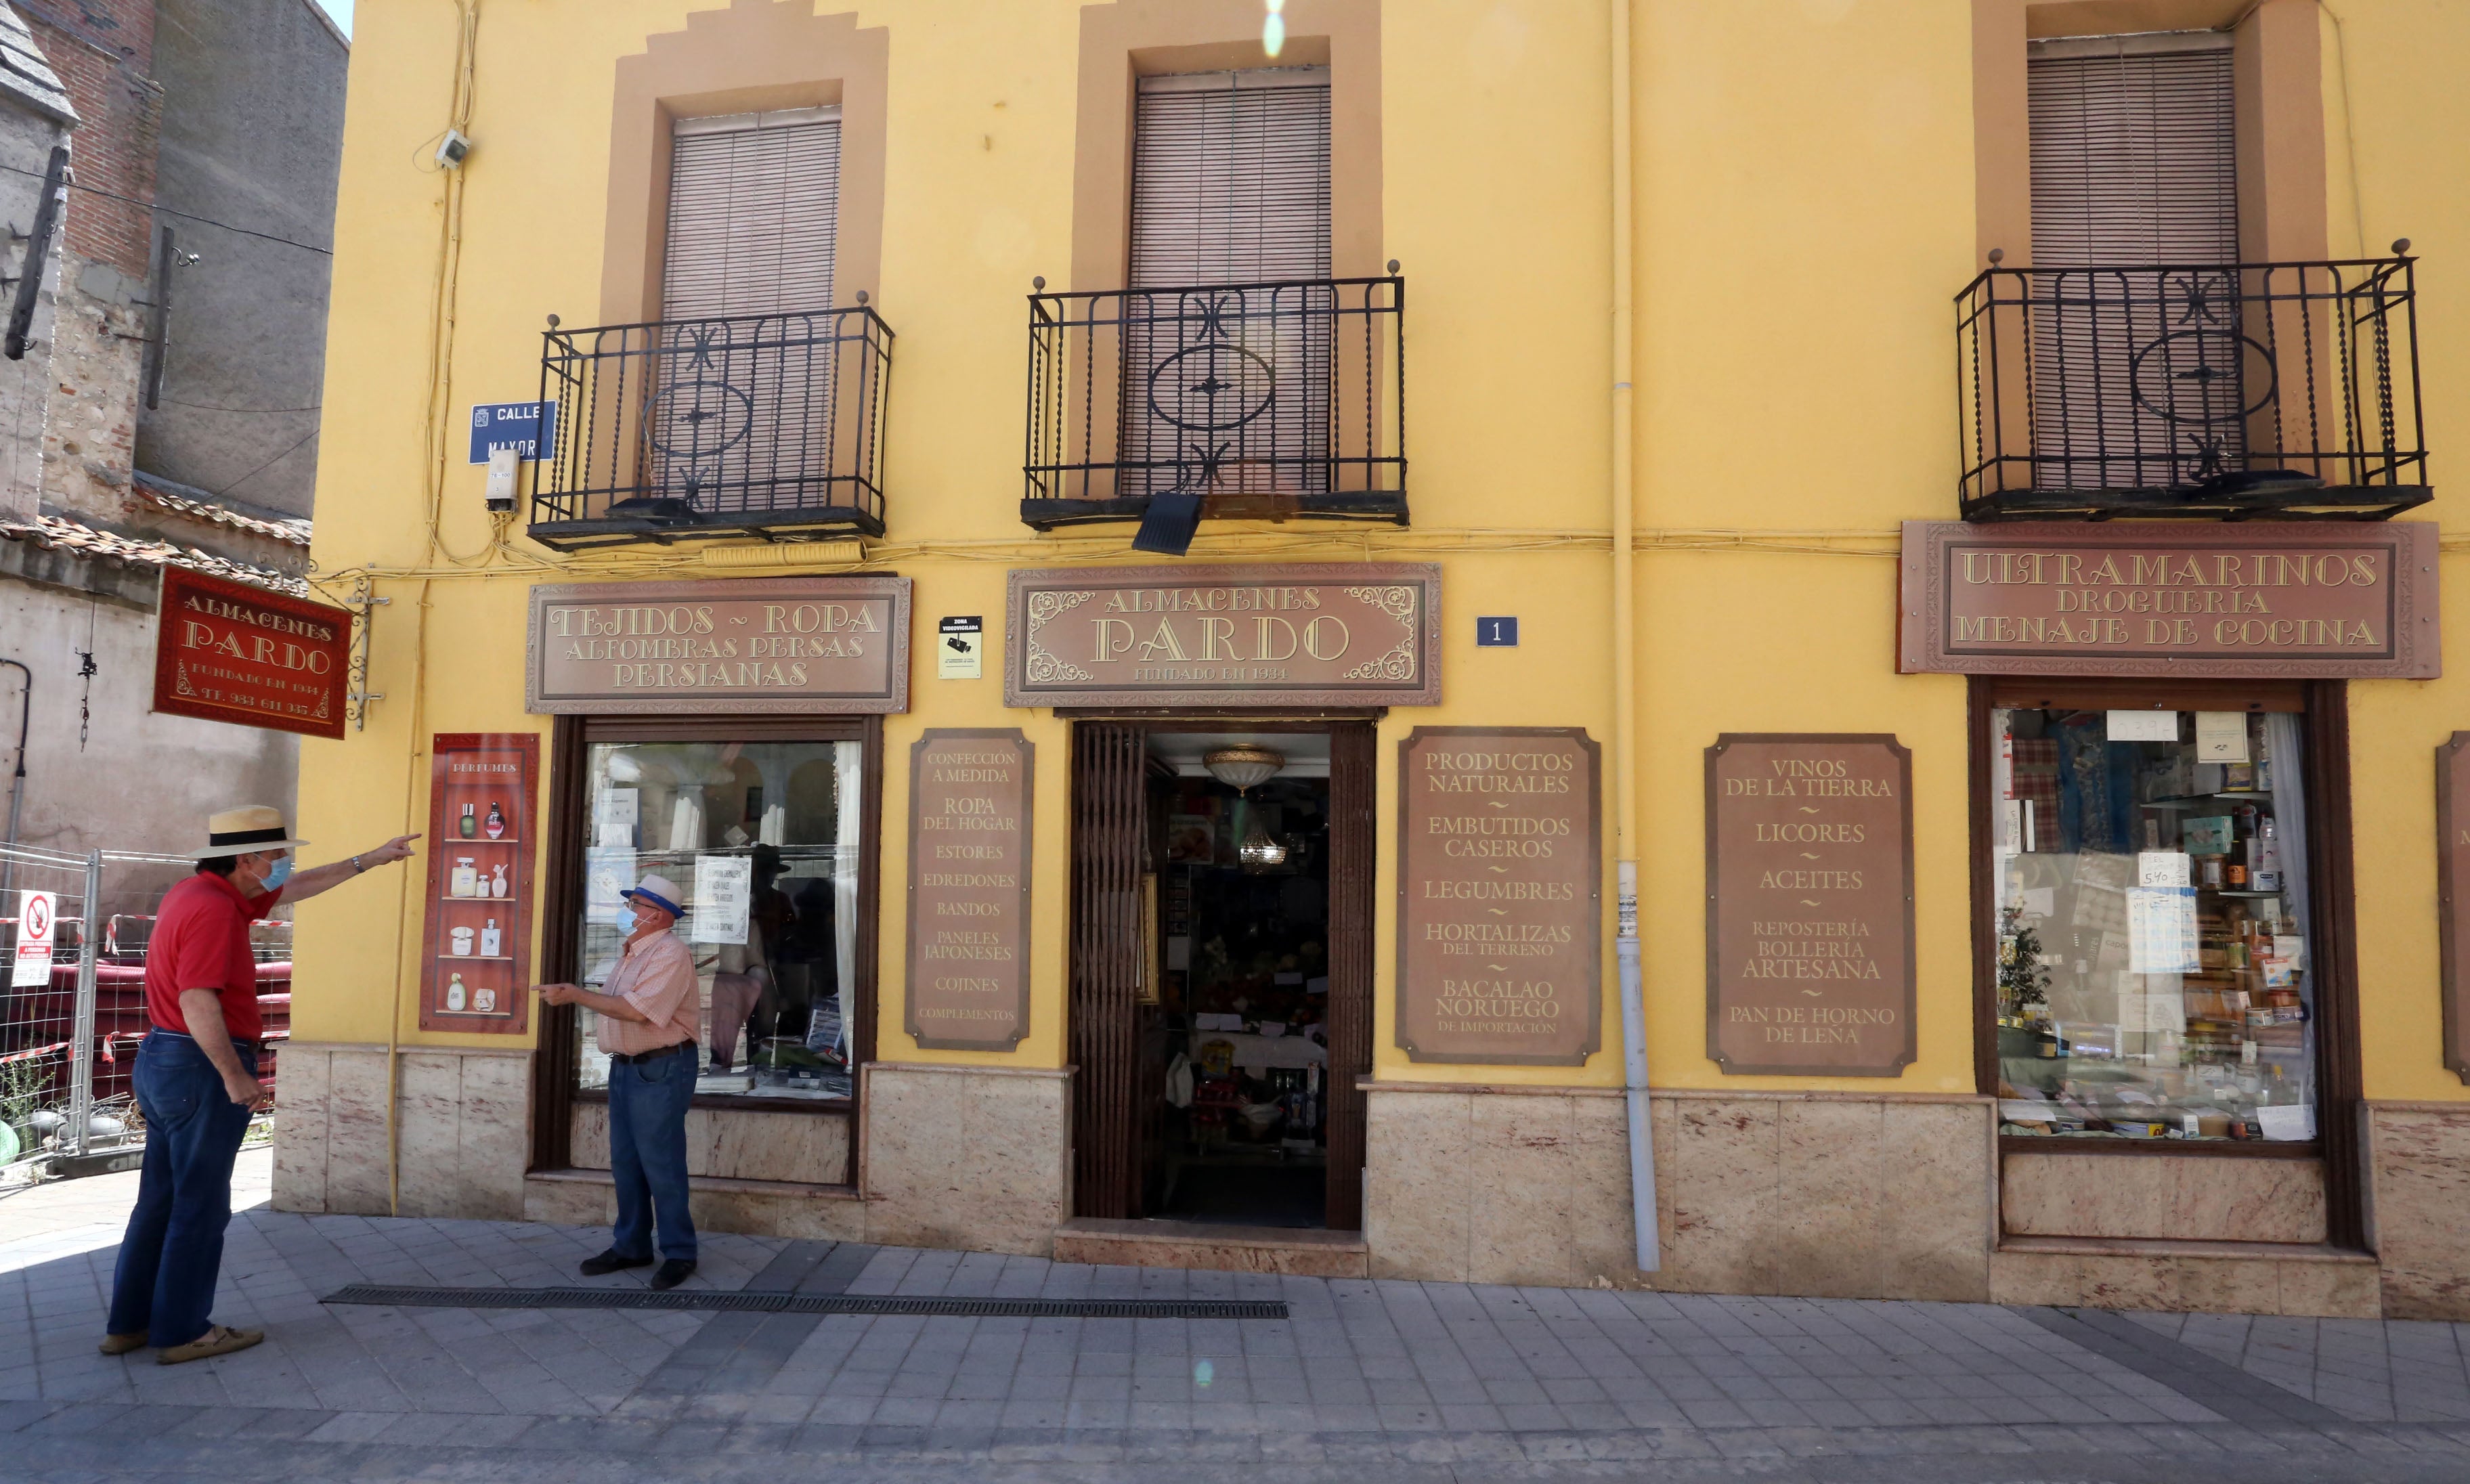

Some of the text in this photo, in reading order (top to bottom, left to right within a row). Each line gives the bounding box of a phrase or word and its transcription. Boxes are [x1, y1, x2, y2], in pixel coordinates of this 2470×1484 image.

[498, 406, 540, 420] CALLE
[1960, 552, 2377, 587] ULTRAMARINOS
[1104, 588, 1322, 613] ALMACENES
[184, 595, 332, 642] ALMACENES
[550, 603, 882, 636] TEJIDOS ROPA
[1089, 615, 1350, 663] PARDO
[1494, 622, 1501, 640] 1
[1955, 616, 2381, 646] MENAJE DE COCINA
[181, 620, 330, 674] PARDO
[565, 636, 864, 661] ALFOMBRAS PERSAS
[192, 663, 263, 684] FUNDADO
[266, 677, 286, 690] EN
[611, 662, 808, 687] PERSIANAS
[1134, 668, 1288, 681] FUNDADO EN 1934
[230, 694, 255, 706] 983
[261, 698, 282, 711] 611
[928, 750, 1016, 764] CONFECCIÓN
[1425, 753, 1573, 771] PRODUCTOS
[453, 764, 517, 773] PERFUMES
[932, 769, 1010, 782] A MEDIDA
[1772, 760, 1846, 777] VINOS
[1429, 775, 1569, 793] NATURALES
[1726, 779, 1892, 797] DE LA TIERRA
[945, 798, 996, 814] ROPA
[924, 817, 1016, 830] DEL HOGAR
[1427, 817, 1570, 835] EMBUTIDOS
[1756, 823, 1865, 843] LICORES
[936, 846, 1003, 859] ESTORES
[1445, 839, 1553, 858] CASEROS
[924, 873, 1015, 887] EDREDONES
[1759, 870, 1863, 890] ACEITES
[1424, 881, 1574, 900] LEGUMBRES
[937, 902, 1000, 916] BANDOS
[1425, 923, 1572, 943] HORTALIZAS
[1752, 918, 1869, 936] REPOSTERÍA
[937, 931, 999, 944] PANELES
[924, 944, 1012, 961] JAPONESES
[1443, 943, 1554, 957] DEL TERRENO
[1758, 937, 1865, 958] BOLLERÍA
[1741, 958, 1882, 980] ARTESANA
[935, 976, 999, 992] COJINES
[1443, 980, 1553, 999] BACALAO
[919, 1007, 1014, 1021] COMPLEMENTOS
[1435, 999, 1559, 1018] NORUEGO
[1729, 1006, 1895, 1024] PAN DE HORNO
[1438, 1019, 1557, 1034] DE IMPORTACIÓN
[1765, 1023, 1859, 1043] DE LEÑA
